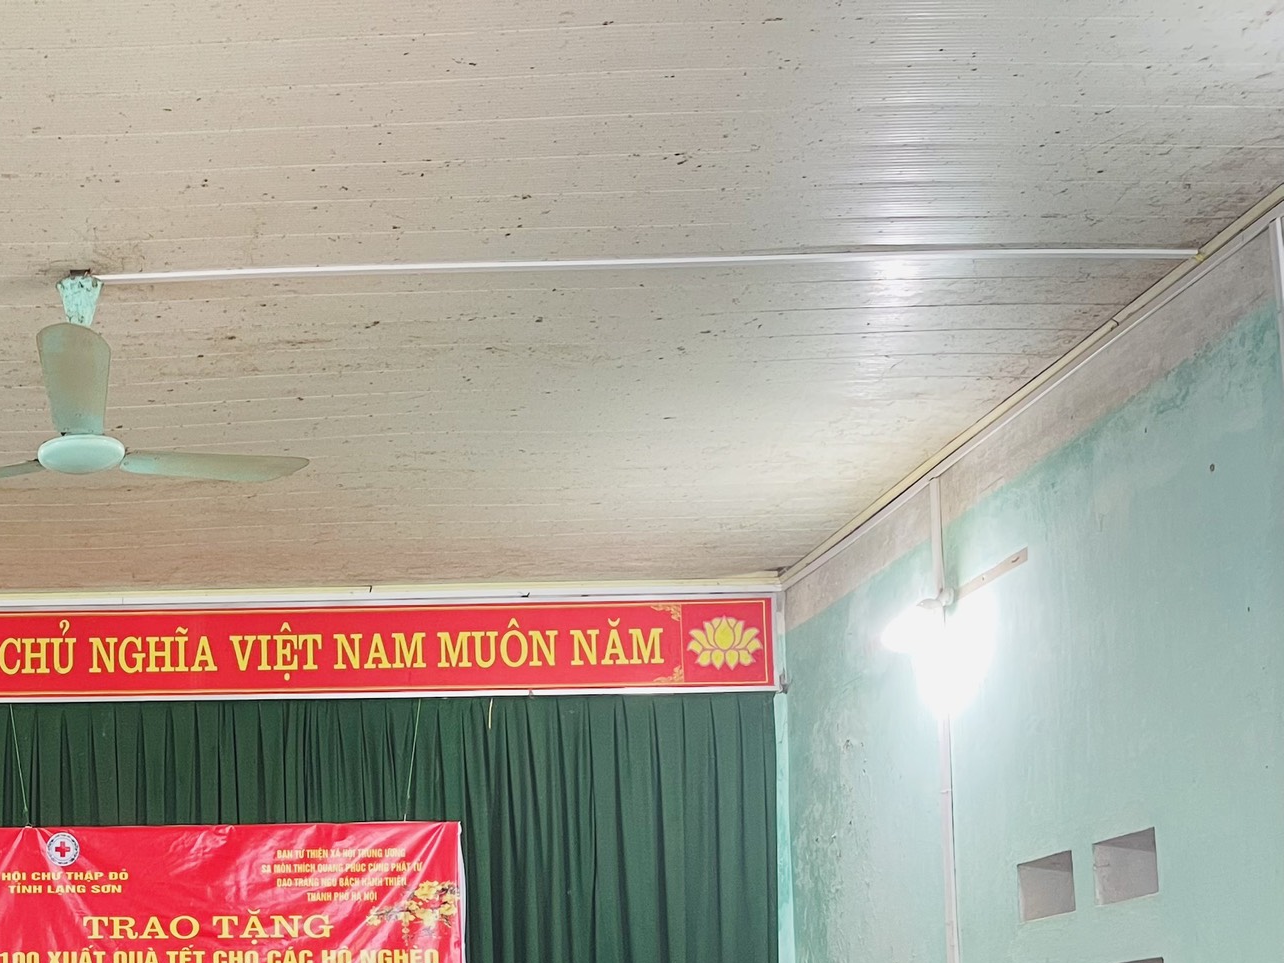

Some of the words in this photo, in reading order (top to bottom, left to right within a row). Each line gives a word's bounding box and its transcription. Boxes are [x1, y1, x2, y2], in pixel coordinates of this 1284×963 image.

[89, 627, 218, 674] NGHĨA
[229, 622, 322, 681] VIỆT
[333, 632, 427, 669] NAM
[437, 618, 558, 669] MUÔN
[570, 618, 664, 667] NĂM
[1, 871, 26, 882] HỘI
[66, 870, 104, 882] THẬP
[108, 868, 129, 880] ĐỎ
[8, 883, 42, 894] TỈNH
[47, 885, 86, 895] LẠNG
[91, 884, 122, 894] SƠN
[82, 915, 200, 940] TRAO
[212, 909, 334, 945] TẶNG
